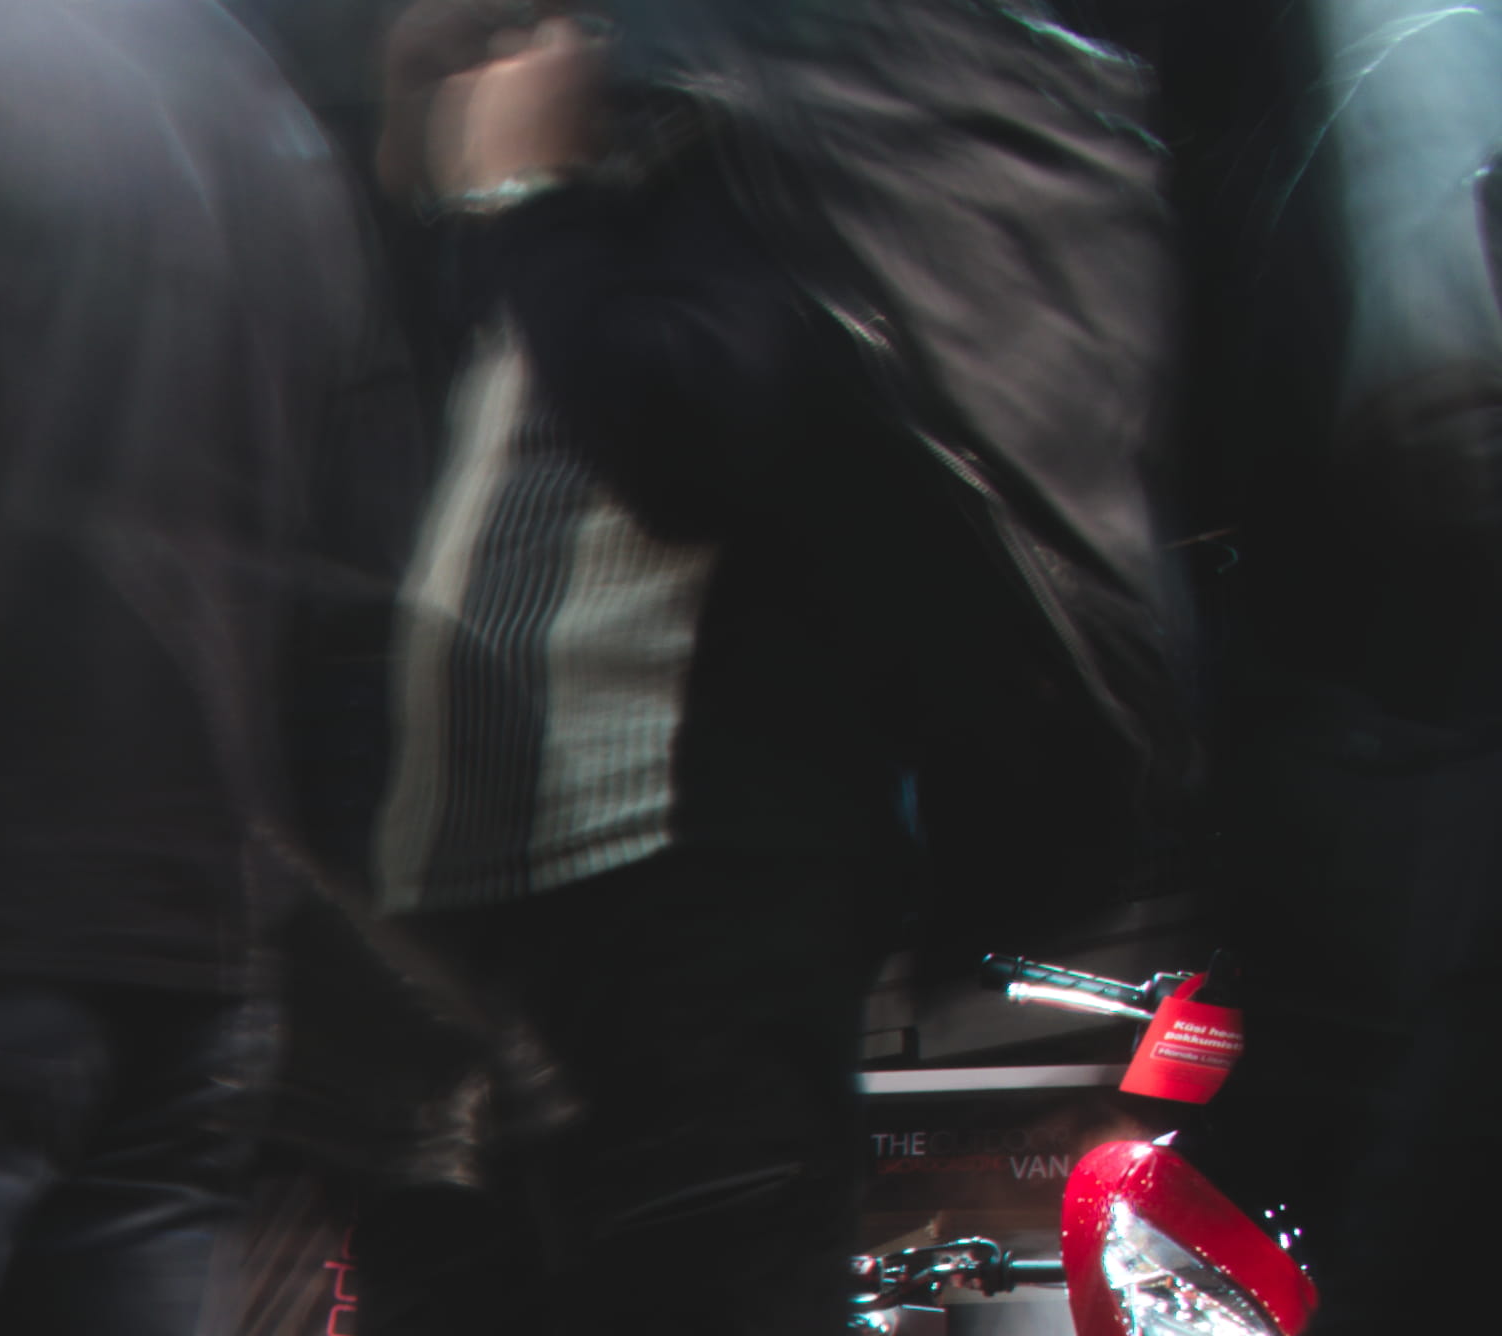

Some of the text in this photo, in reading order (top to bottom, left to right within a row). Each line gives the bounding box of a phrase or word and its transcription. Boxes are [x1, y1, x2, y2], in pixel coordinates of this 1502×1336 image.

[1163, 1031, 1244, 1050] pakkumist
[872, 1132, 928, 1157] THE
[1009, 1154, 1070, 1180] VAN
